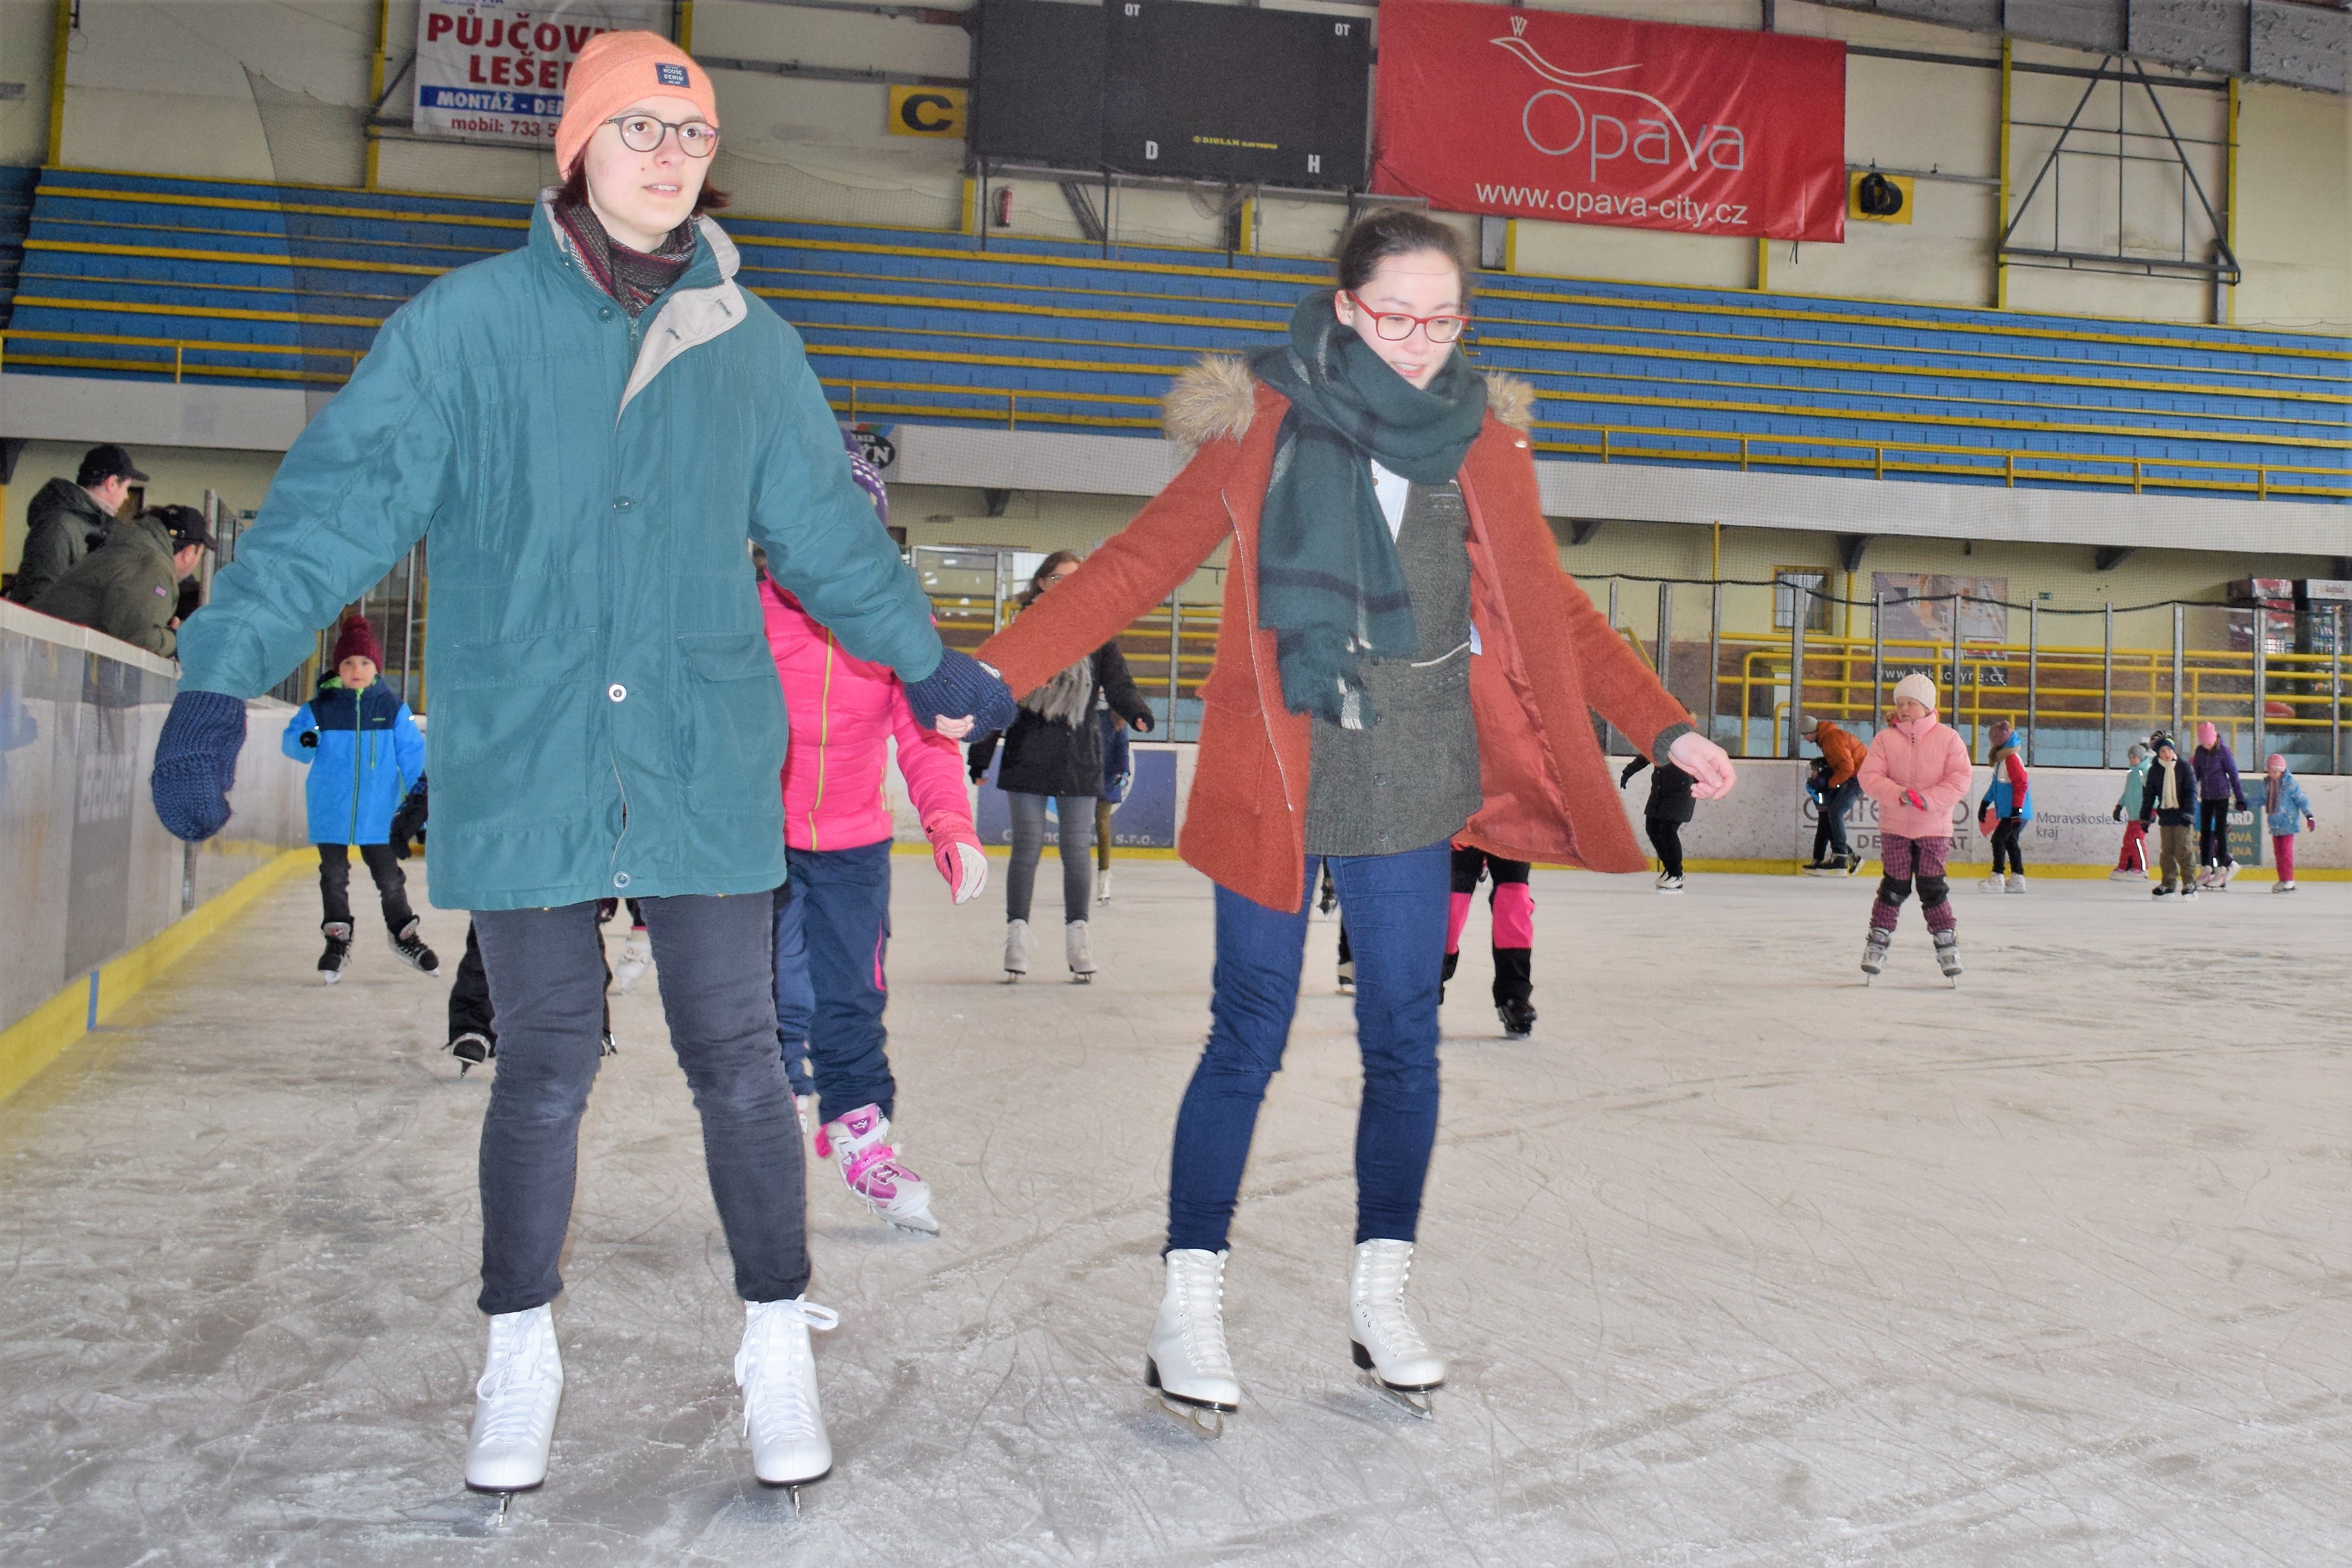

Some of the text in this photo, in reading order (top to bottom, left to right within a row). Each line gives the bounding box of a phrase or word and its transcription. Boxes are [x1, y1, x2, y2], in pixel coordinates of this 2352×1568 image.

[1124, 3, 1141, 16] OT
[427, 7, 619, 54] PŮJČOV
[1334, 23, 1350, 36] OT
[437, 90, 514, 111] MONTÁŽ
[901, 94, 954, 131] C
[451, 117, 504, 133] mobil:
[511, 120, 541, 136] 733
[1522, 89, 1744, 183] Opava
[1145, 141, 1159, 160] D
[1308, 154, 1320, 173] H
[1475, 183, 1748, 228] www.opava-city.cz
[1115, 834, 1155, 845] s.r.o.
[2036, 826, 2058, 841] kraj
